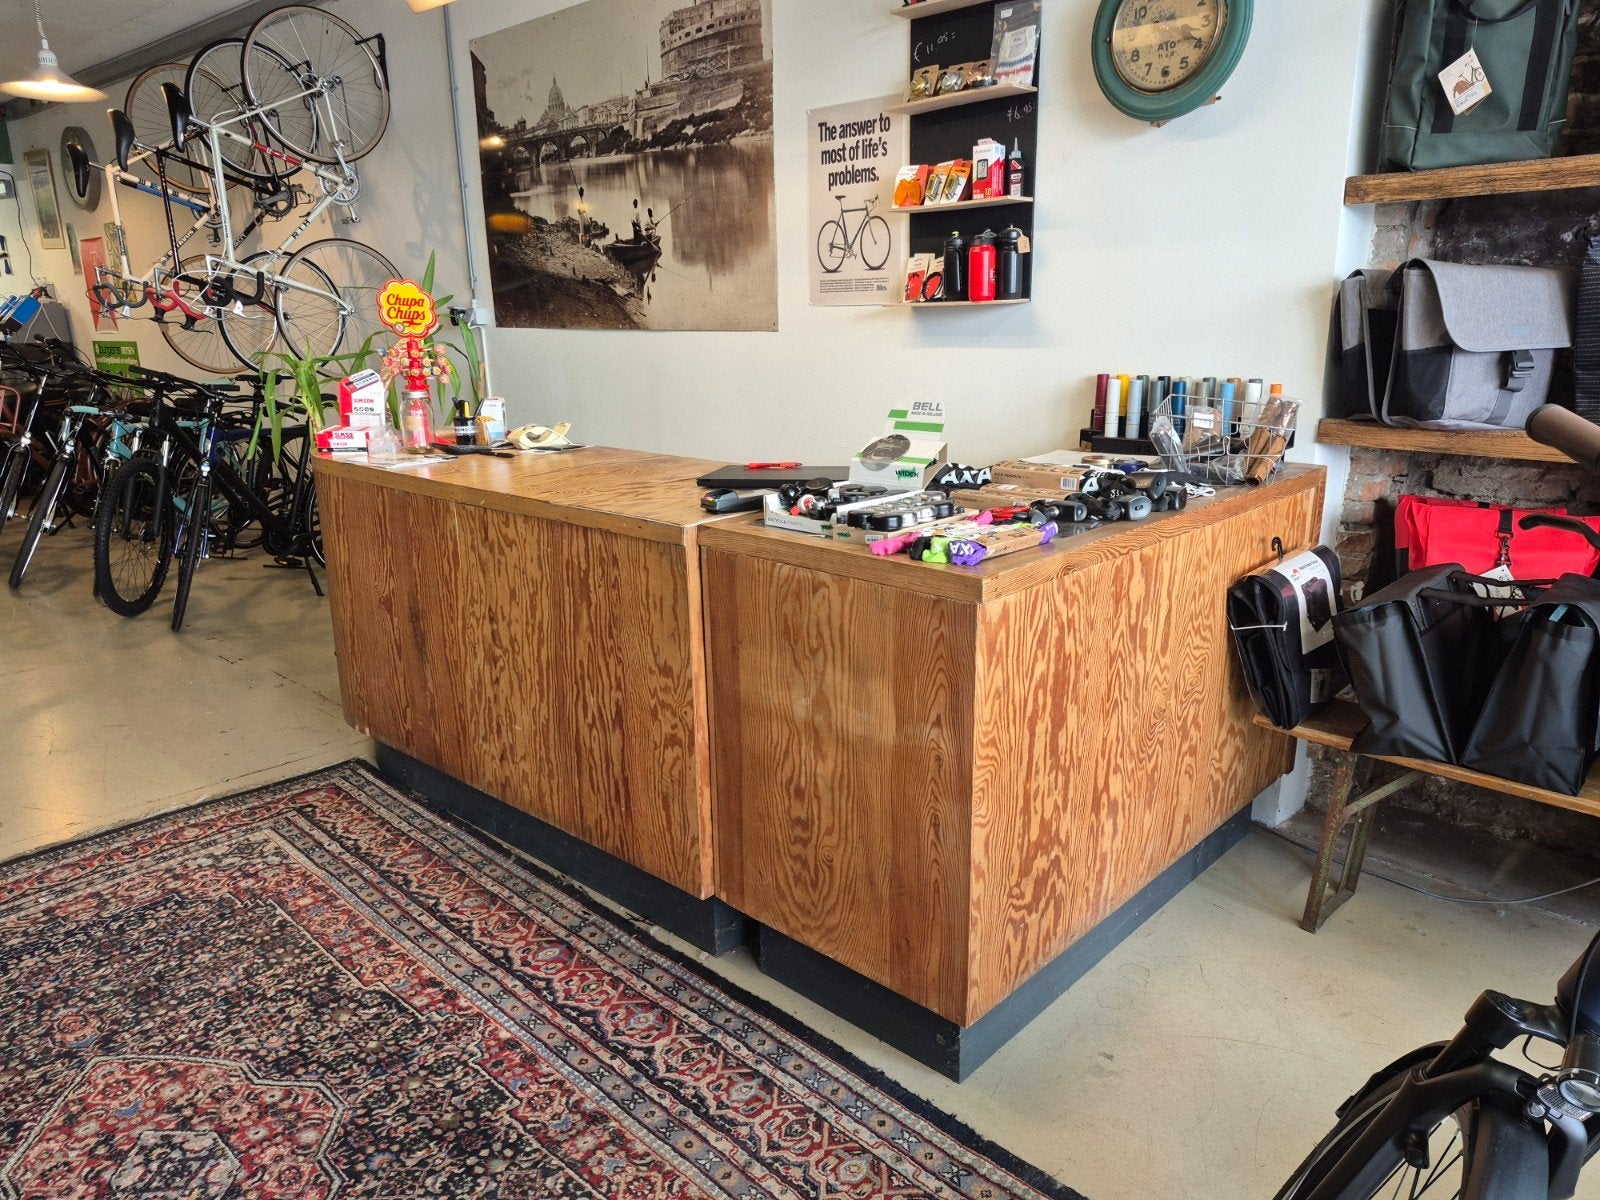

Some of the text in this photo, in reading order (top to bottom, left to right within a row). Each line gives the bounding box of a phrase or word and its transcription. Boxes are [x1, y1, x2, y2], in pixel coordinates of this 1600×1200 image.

[1130, 49, 1141, 63] 8
[1179, 56, 1190, 70] 5
[1144, 62, 1153, 77] 7
[1161, 66, 1171, 79] 6
[818, 112, 891, 143] The answer to
[821, 136, 888, 165] most of life's
[828, 164, 880, 192] problems.
[291, 219, 310, 239] RIH
[386, 293, 425, 310] Chupa
[386, 306, 426, 327] Chups
[912, 401, 943, 412] BELL
[940, 467, 992, 485] AXA
